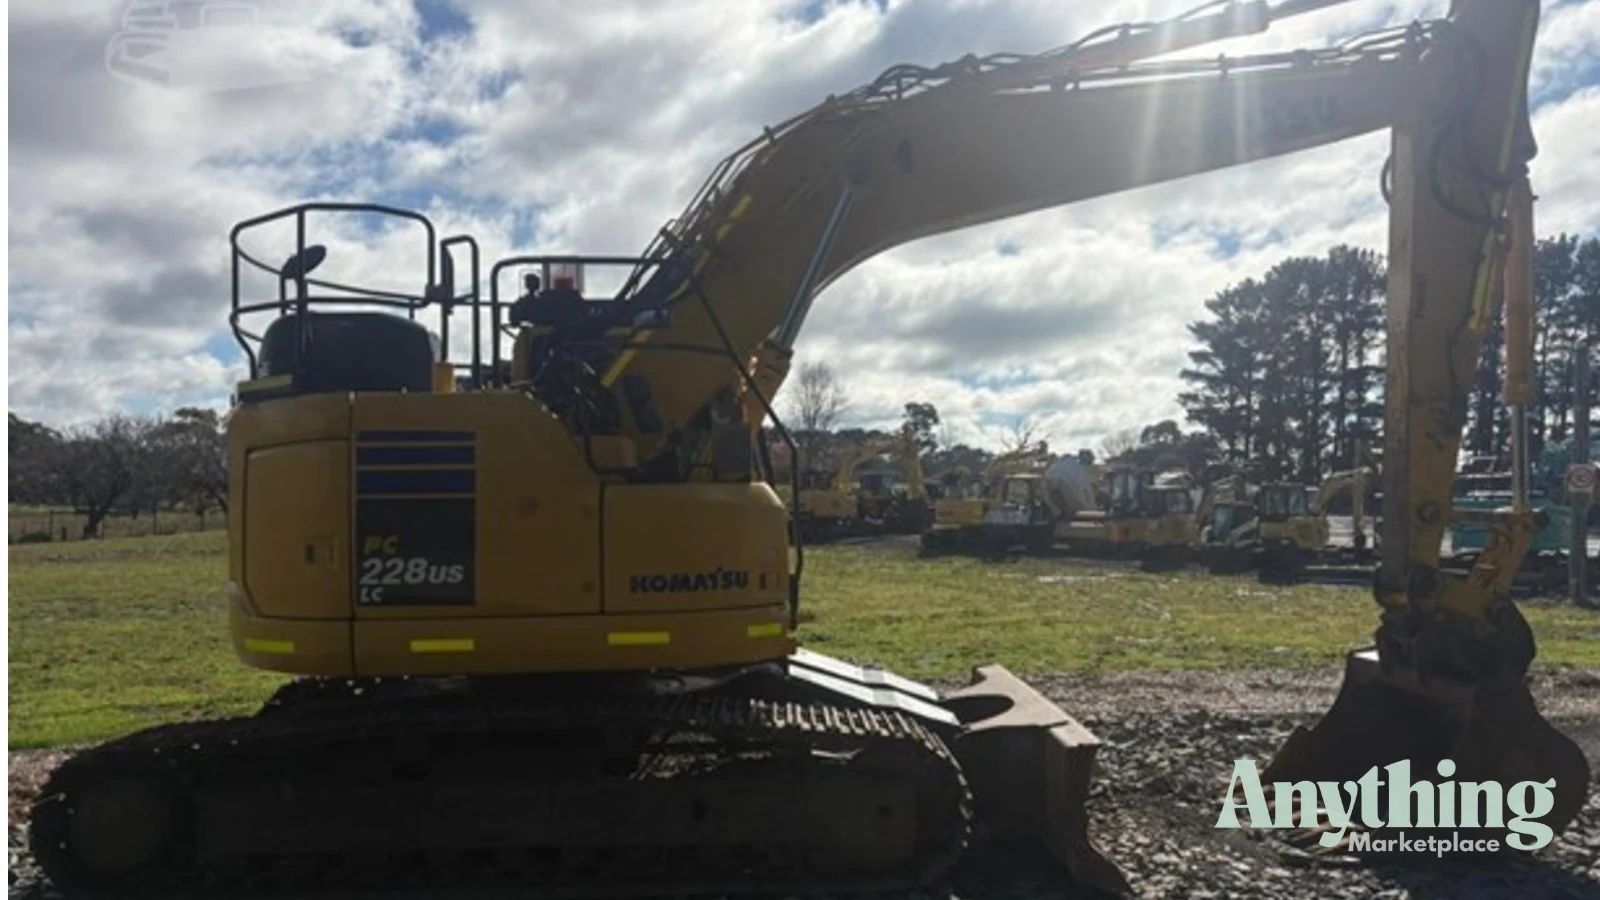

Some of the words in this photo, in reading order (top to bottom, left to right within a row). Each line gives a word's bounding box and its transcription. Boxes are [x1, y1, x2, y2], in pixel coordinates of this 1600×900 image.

[363, 535, 399, 555] PC
[629, 566, 749, 593] KOMATSU
[359, 586, 384, 603] LC
